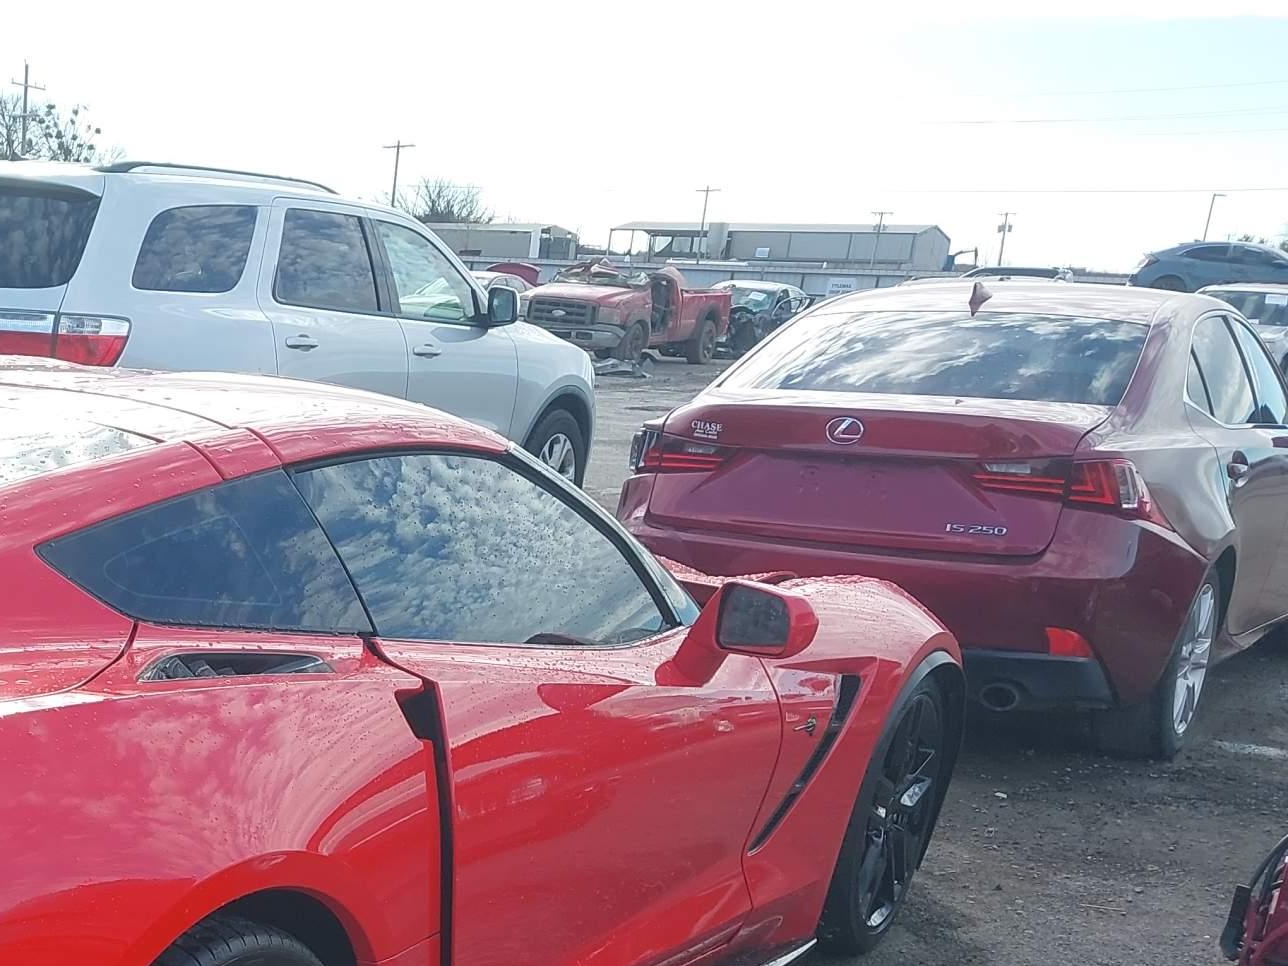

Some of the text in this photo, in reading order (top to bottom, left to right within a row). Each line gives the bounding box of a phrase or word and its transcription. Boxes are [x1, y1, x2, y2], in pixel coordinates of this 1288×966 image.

[691, 420, 722, 432] CHASE
[945, 523, 1007, 535] IS 250
